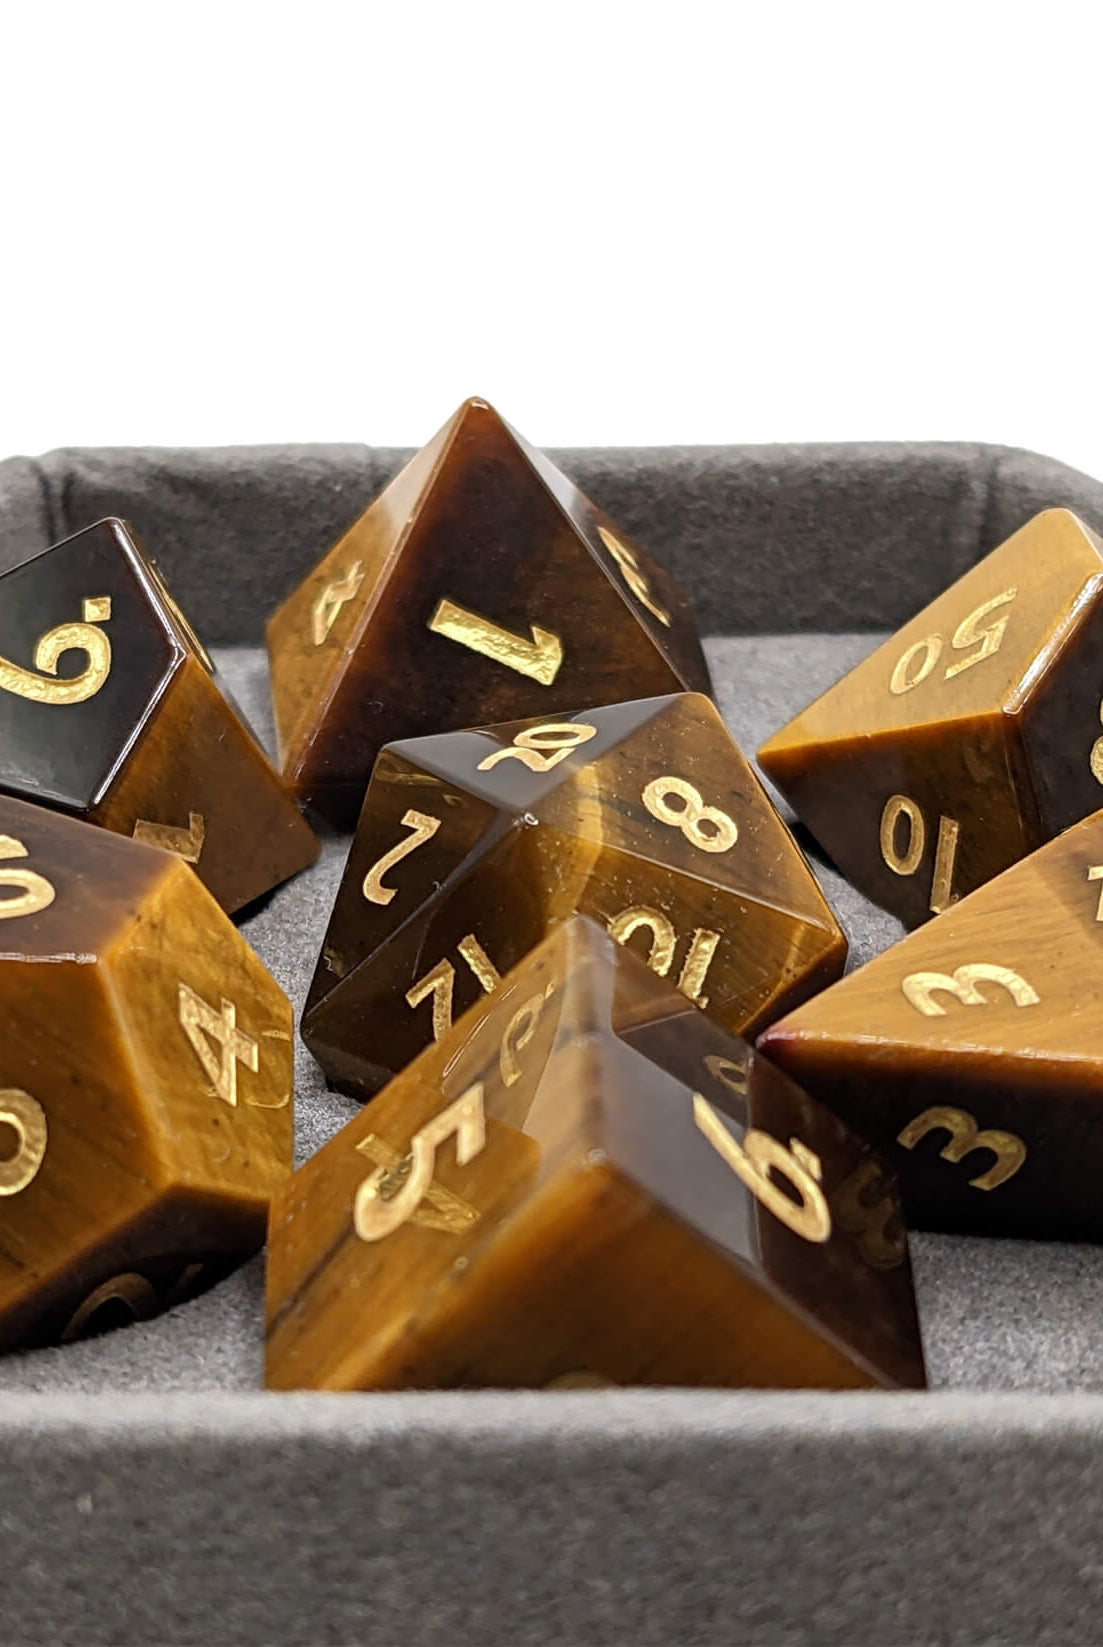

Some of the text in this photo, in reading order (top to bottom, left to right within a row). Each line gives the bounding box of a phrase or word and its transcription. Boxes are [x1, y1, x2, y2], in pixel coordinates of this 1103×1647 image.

[428, 599, 563, 686] 1
[477, 723, 597, 772] 20
[363, 809, 442, 906] 2
[641, 776, 738, 853] 8
[902, 963, 1040, 1017] 3
[178, 982, 259, 1107] 4
[355, 1082, 485, 1242] 5
[896, 1106, 1027, 1191] 3
